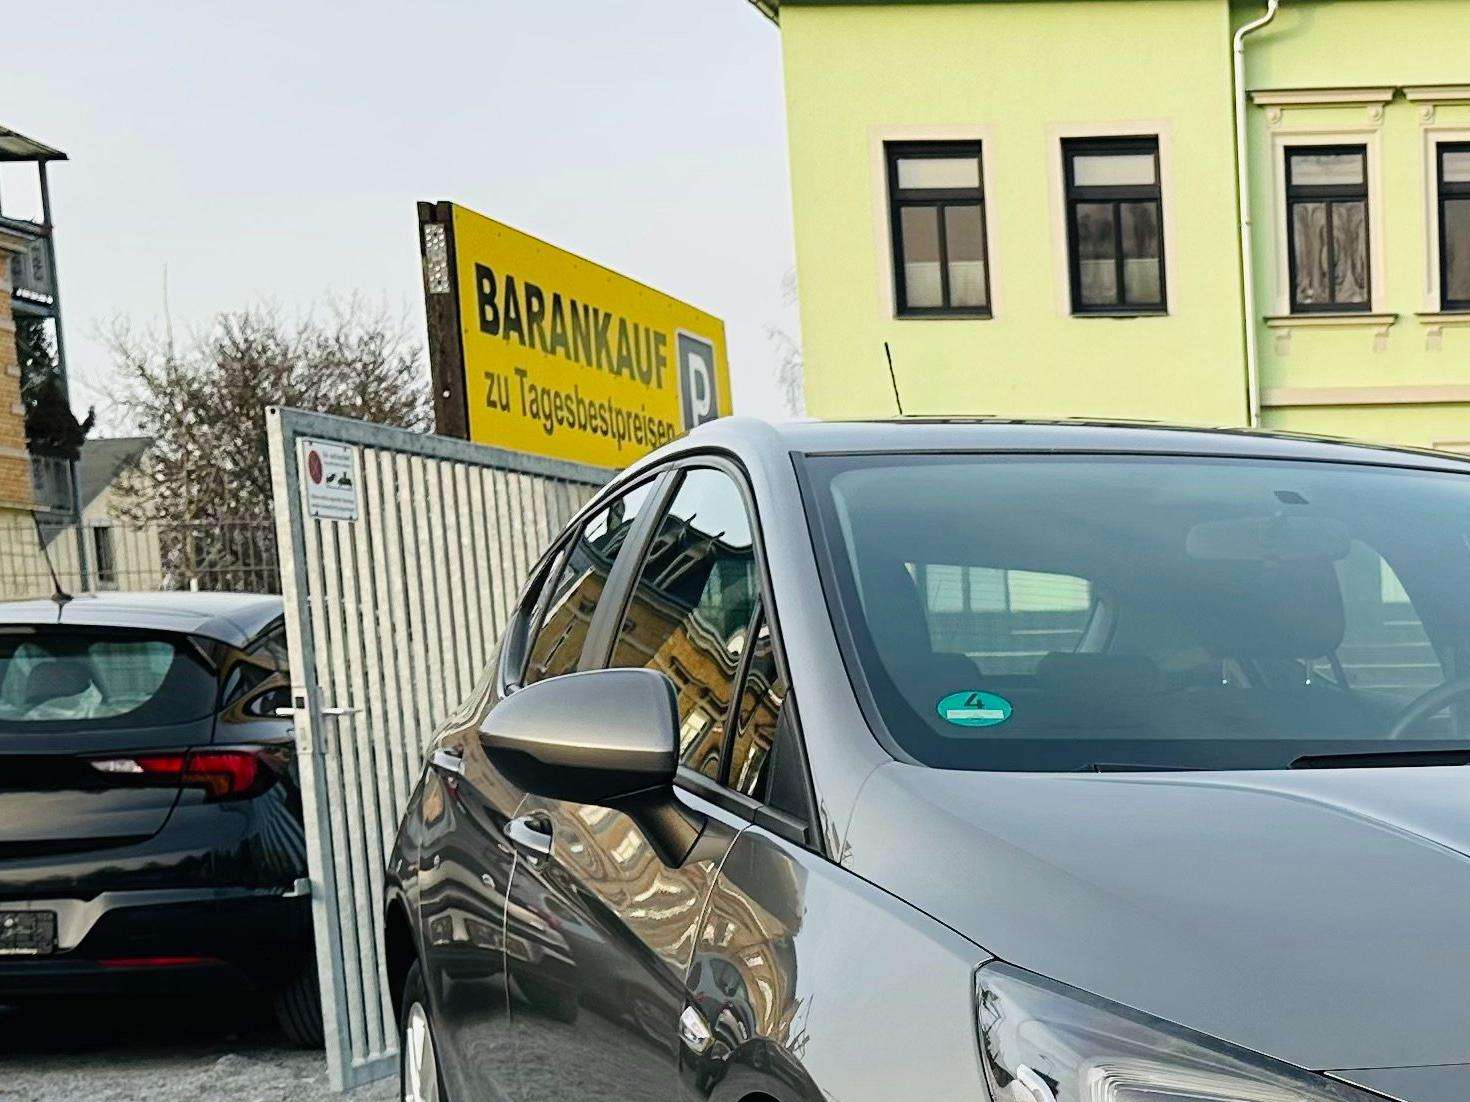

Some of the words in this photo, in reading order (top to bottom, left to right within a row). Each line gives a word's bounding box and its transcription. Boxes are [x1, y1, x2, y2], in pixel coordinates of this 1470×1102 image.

[475, 262, 667, 390] BARANKAUF
[484, 371, 509, 412] zu
[514, 367, 675, 450] Tagesbestpreisen
[964, 693, 985, 709] 4
